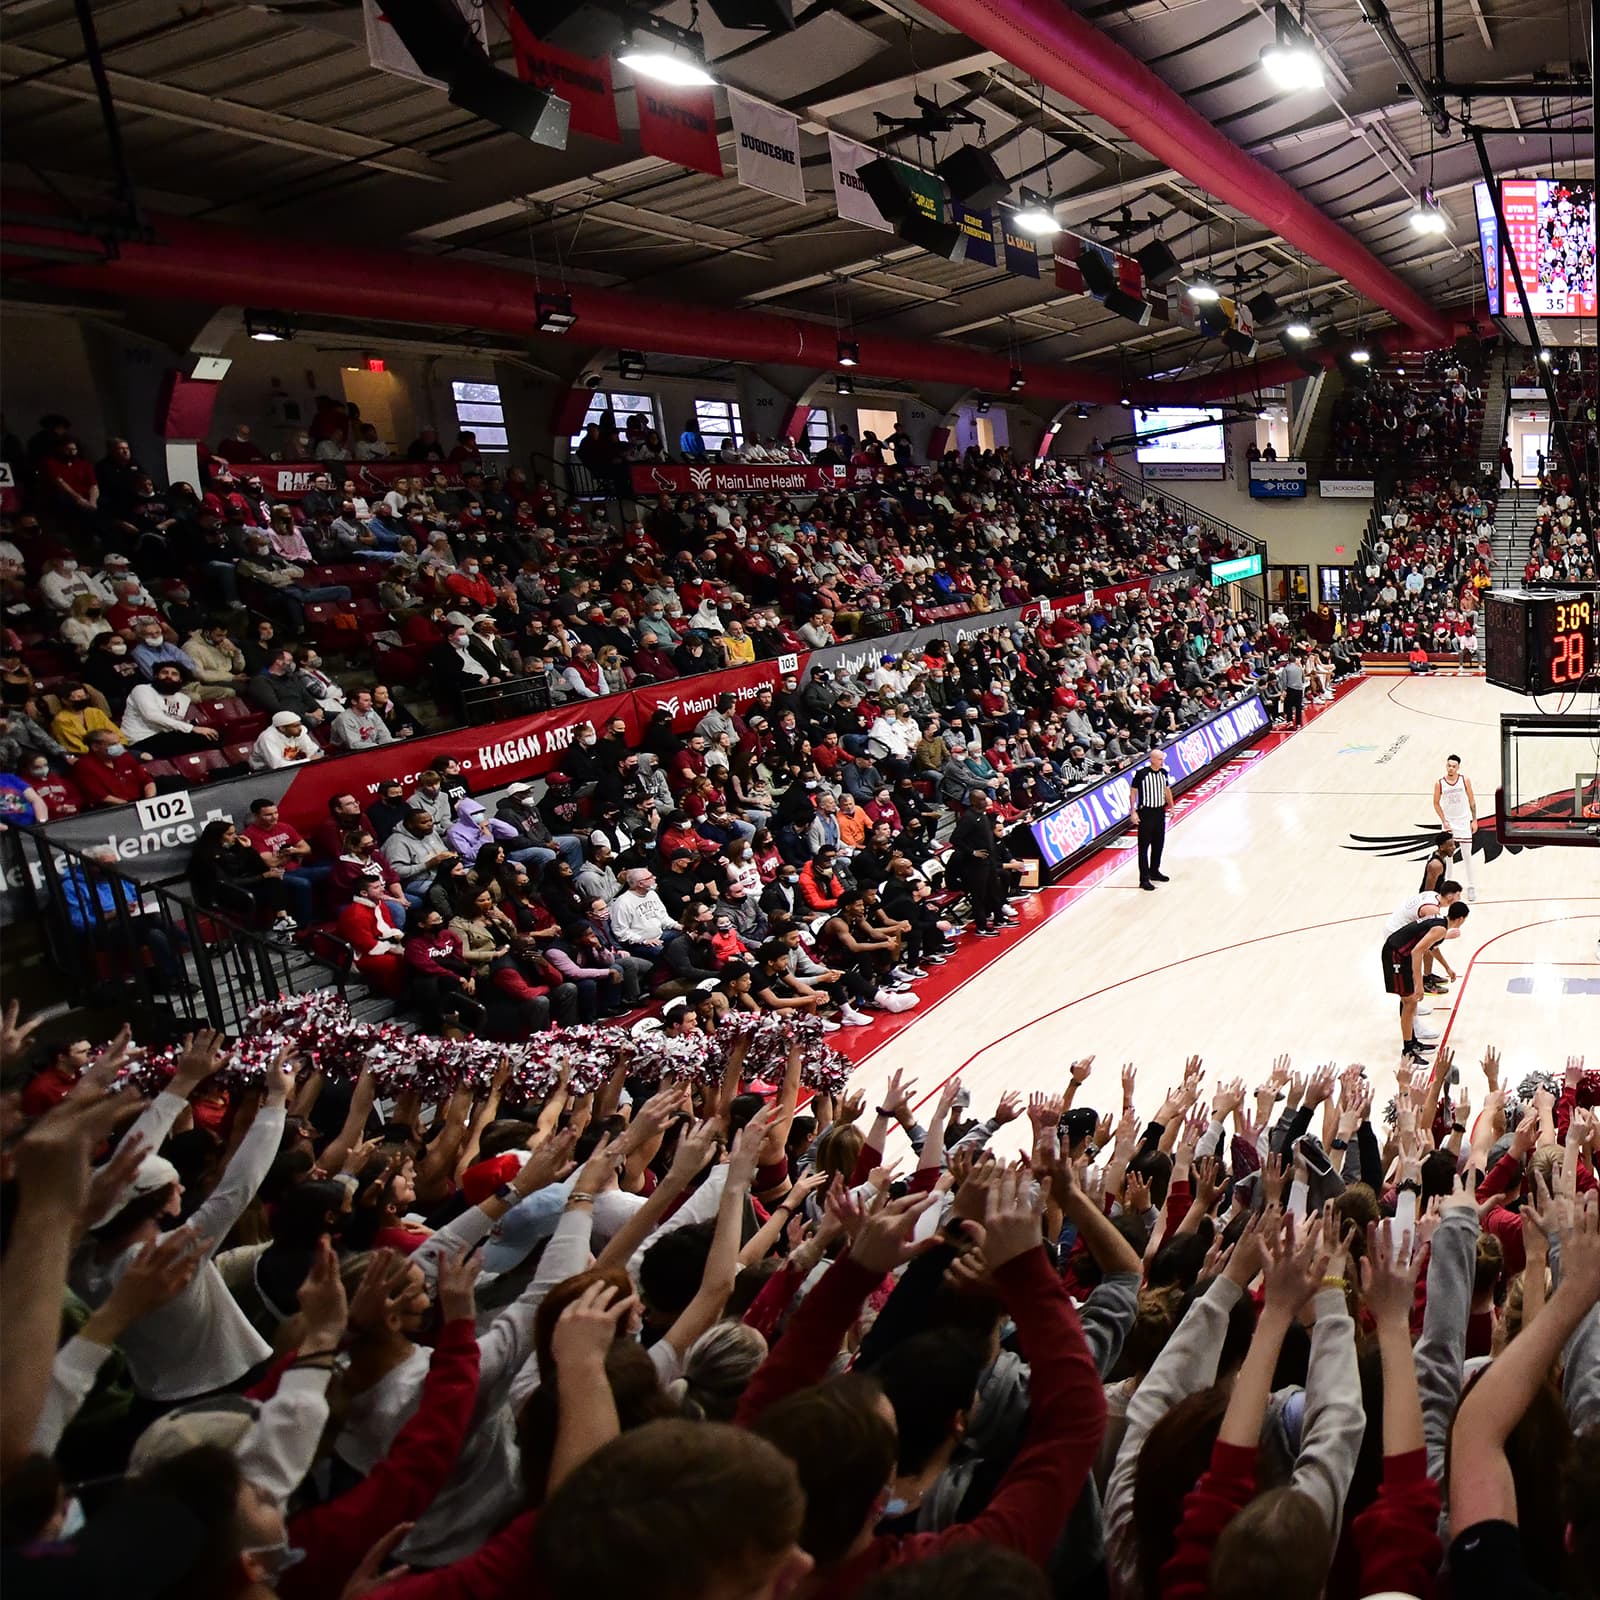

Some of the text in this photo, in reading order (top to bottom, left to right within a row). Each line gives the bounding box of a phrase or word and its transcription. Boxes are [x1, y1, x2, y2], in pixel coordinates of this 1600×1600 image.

[648, 95, 708, 133] DAYTON
[741, 132, 795, 166] DUQUESNE
[1546, 298, 1564, 310] 35
[716, 475, 744, 489] Main
[745, 474, 769, 489] Line
[1276, 481, 1299, 491] PECO
[1557, 602, 1590, 632] 3:09
[781, 658, 796, 670] 103
[1551, 632, 1584, 683] 28
[683, 696, 713, 716] Main
[1206, 698, 1263, 754] A SUB ABOVE
[478, 732, 542, 770] HAGAN
[146, 799, 186, 821] 102
[1090, 795, 1110, 829] A
